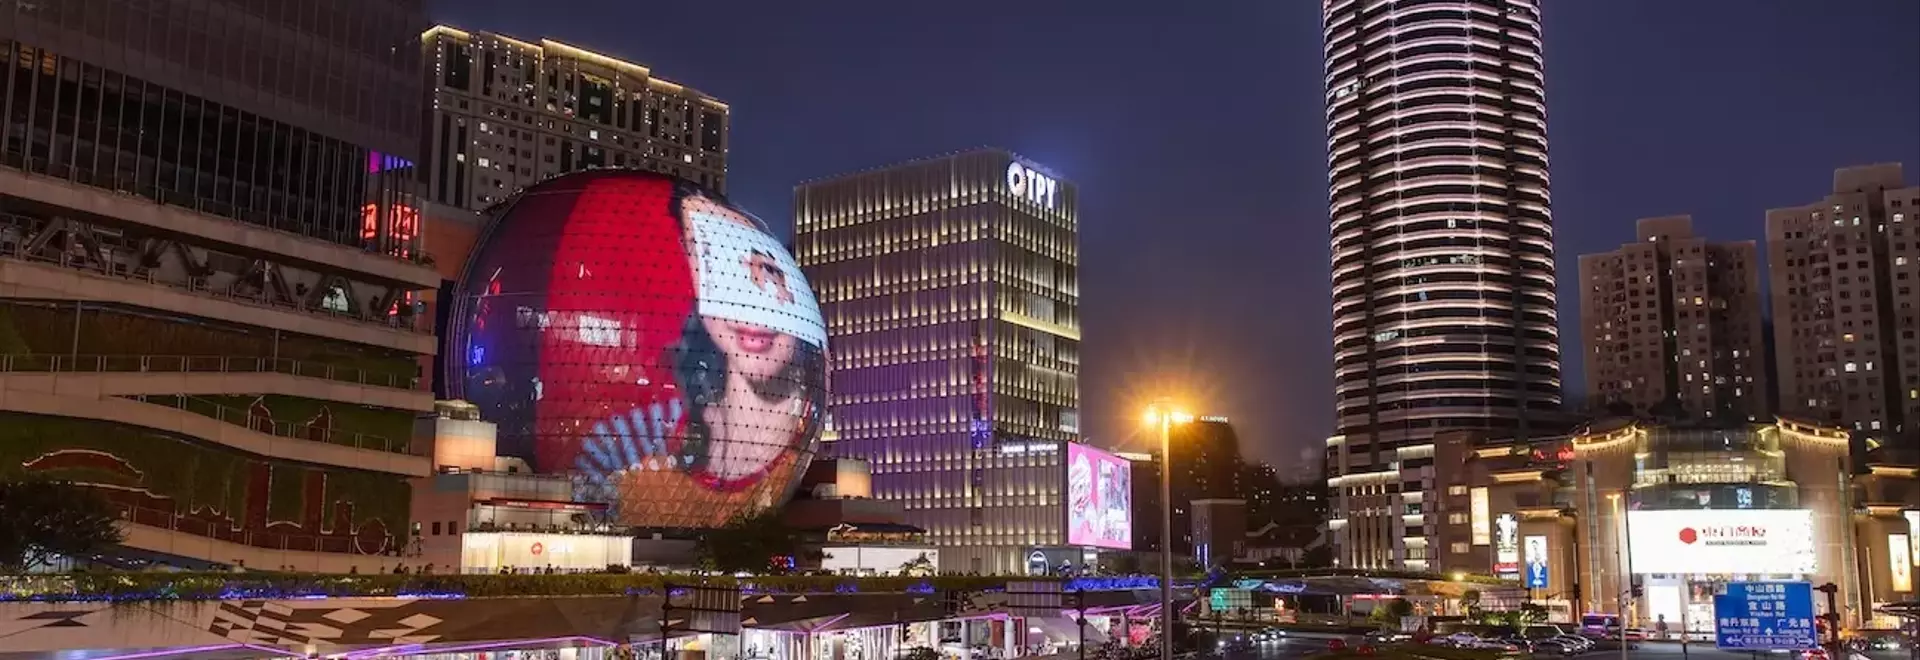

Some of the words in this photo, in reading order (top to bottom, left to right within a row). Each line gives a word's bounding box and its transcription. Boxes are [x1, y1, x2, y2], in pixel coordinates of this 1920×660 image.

[1745, 584, 1785, 593] 中山西路
[1777, 618, 1811, 628] 广元路
